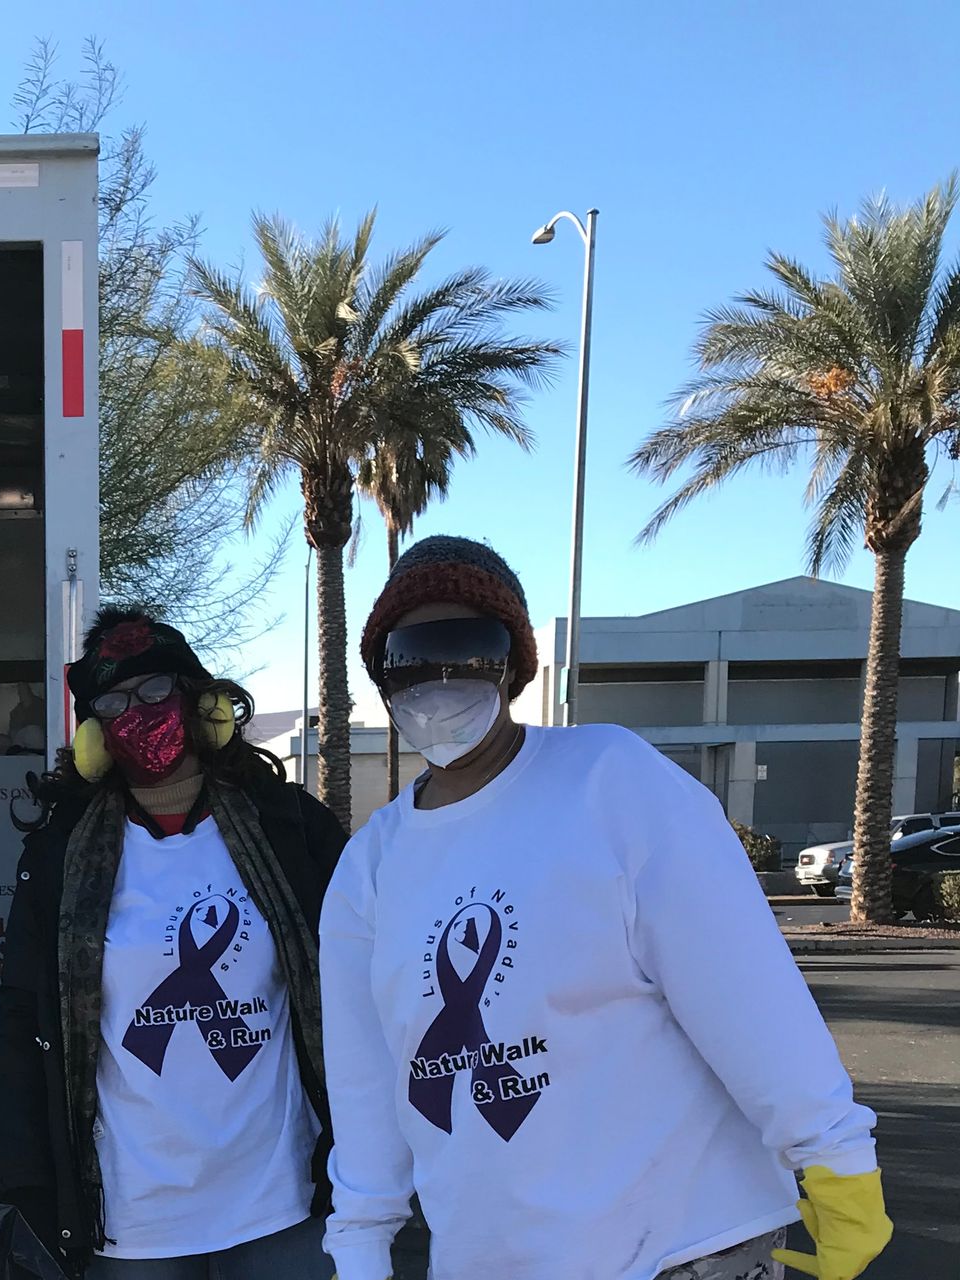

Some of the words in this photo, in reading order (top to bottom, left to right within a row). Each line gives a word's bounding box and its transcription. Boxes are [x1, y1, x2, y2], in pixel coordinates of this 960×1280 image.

[162, 904, 185, 957] Lupus
[192, 883, 213, 899] of
[421, 918, 443, 998] Lupus
[454, 886, 477, 906] of
[483, 887, 520, 1009] Nevada's
[134, 1005, 212, 1027] Nature
[217, 996, 268, 1018] Walk
[207, 1030, 227, 1049] &
[232, 1026, 272, 1047] Run
[480, 1035, 548, 1067] Walk
[471, 1080, 493, 1104] &
[499, 1071, 551, 1101] Run
